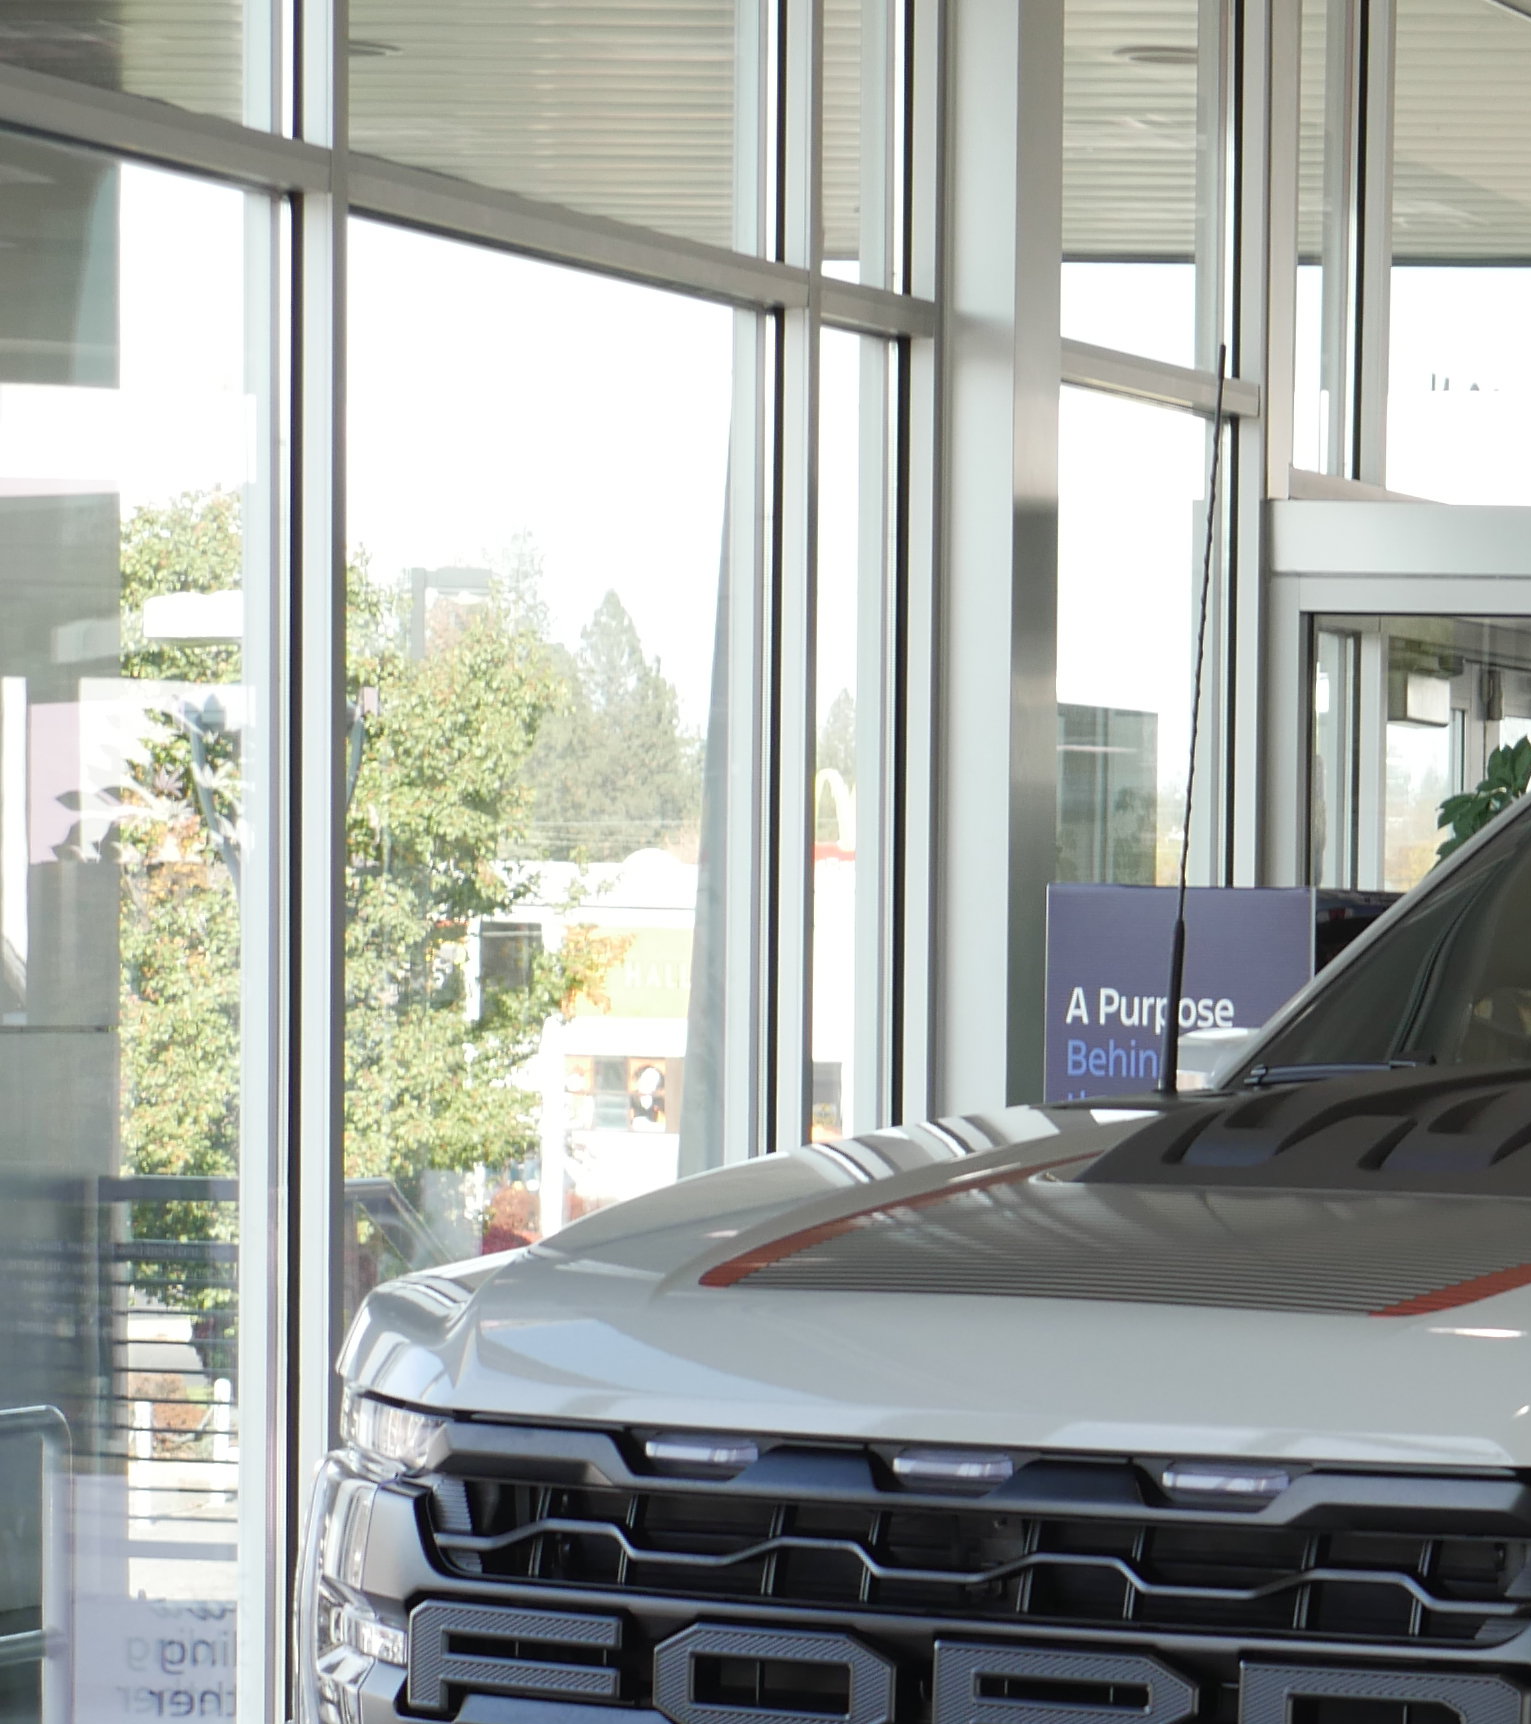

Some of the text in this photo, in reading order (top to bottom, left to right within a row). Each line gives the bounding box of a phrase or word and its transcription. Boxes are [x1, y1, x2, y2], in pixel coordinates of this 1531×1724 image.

[1066, 987, 1234, 1034] A Purpose
[1067, 1039, 1159, 1079] Behin
